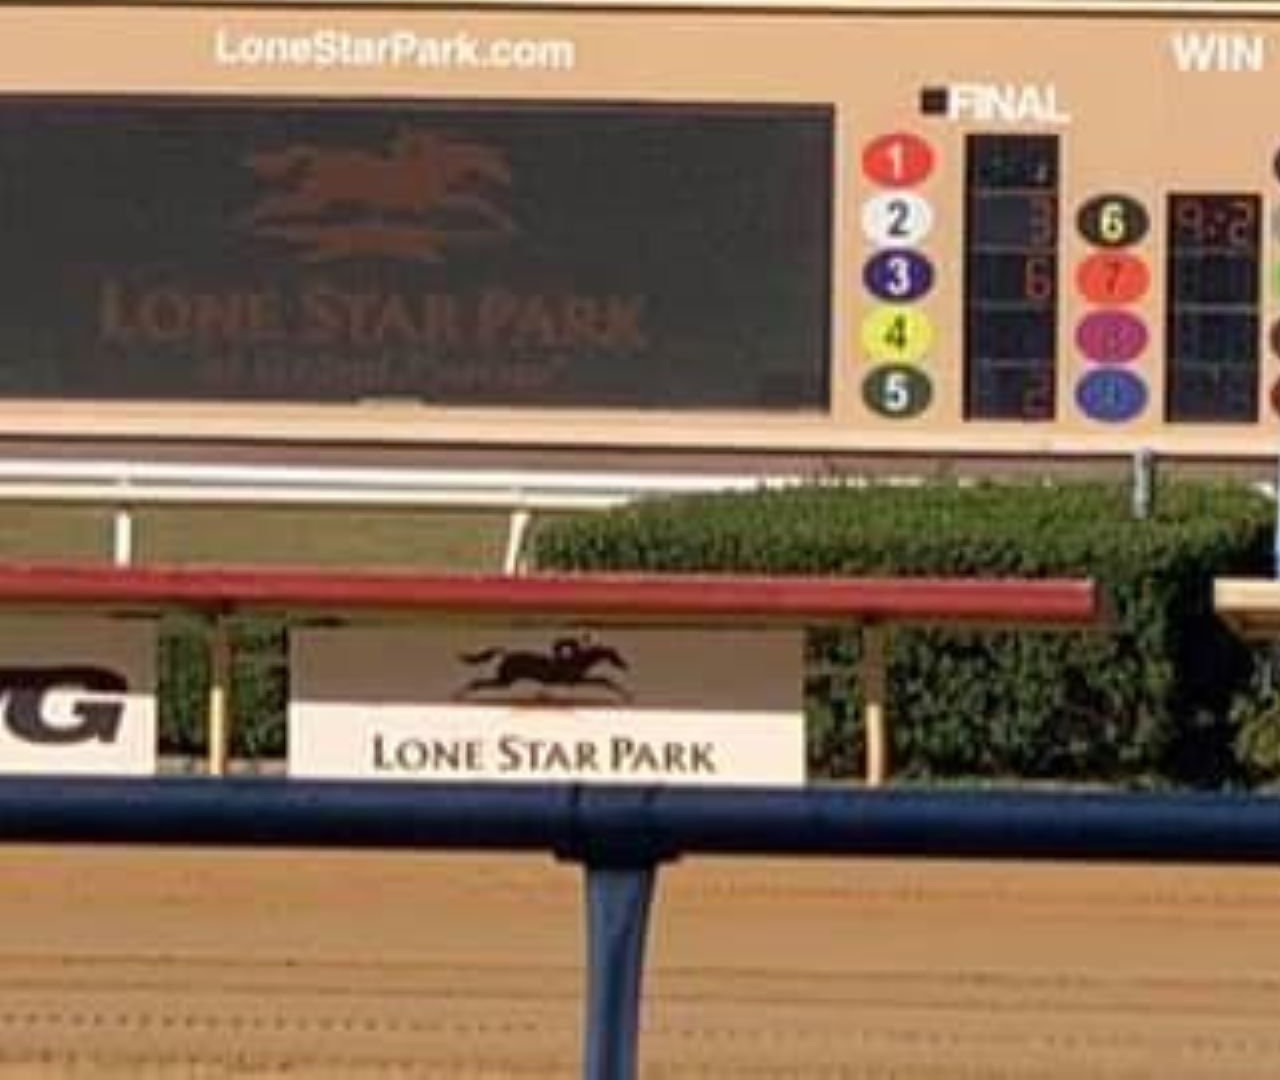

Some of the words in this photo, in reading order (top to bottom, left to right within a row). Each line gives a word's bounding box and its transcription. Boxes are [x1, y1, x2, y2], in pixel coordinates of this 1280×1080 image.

[215, 30, 575, 70] LoneStarPark.com
[1172, 33, 1266, 72] WIN
[948, 83, 1071, 122] FINAL
[887, 145, 905, 177] 1
[887, 200, 909, 237] 2
[1100, 204, 1124, 240] 6
[887, 258, 911, 295] 3
[1104, 261, 1123, 295] 7
[883, 314, 907, 350] 4
[884, 373, 909, 410] 5
[372, 734, 483, 771] LONE
[497, 736, 597, 772] STAR
[609, 736, 716, 773] PARK
